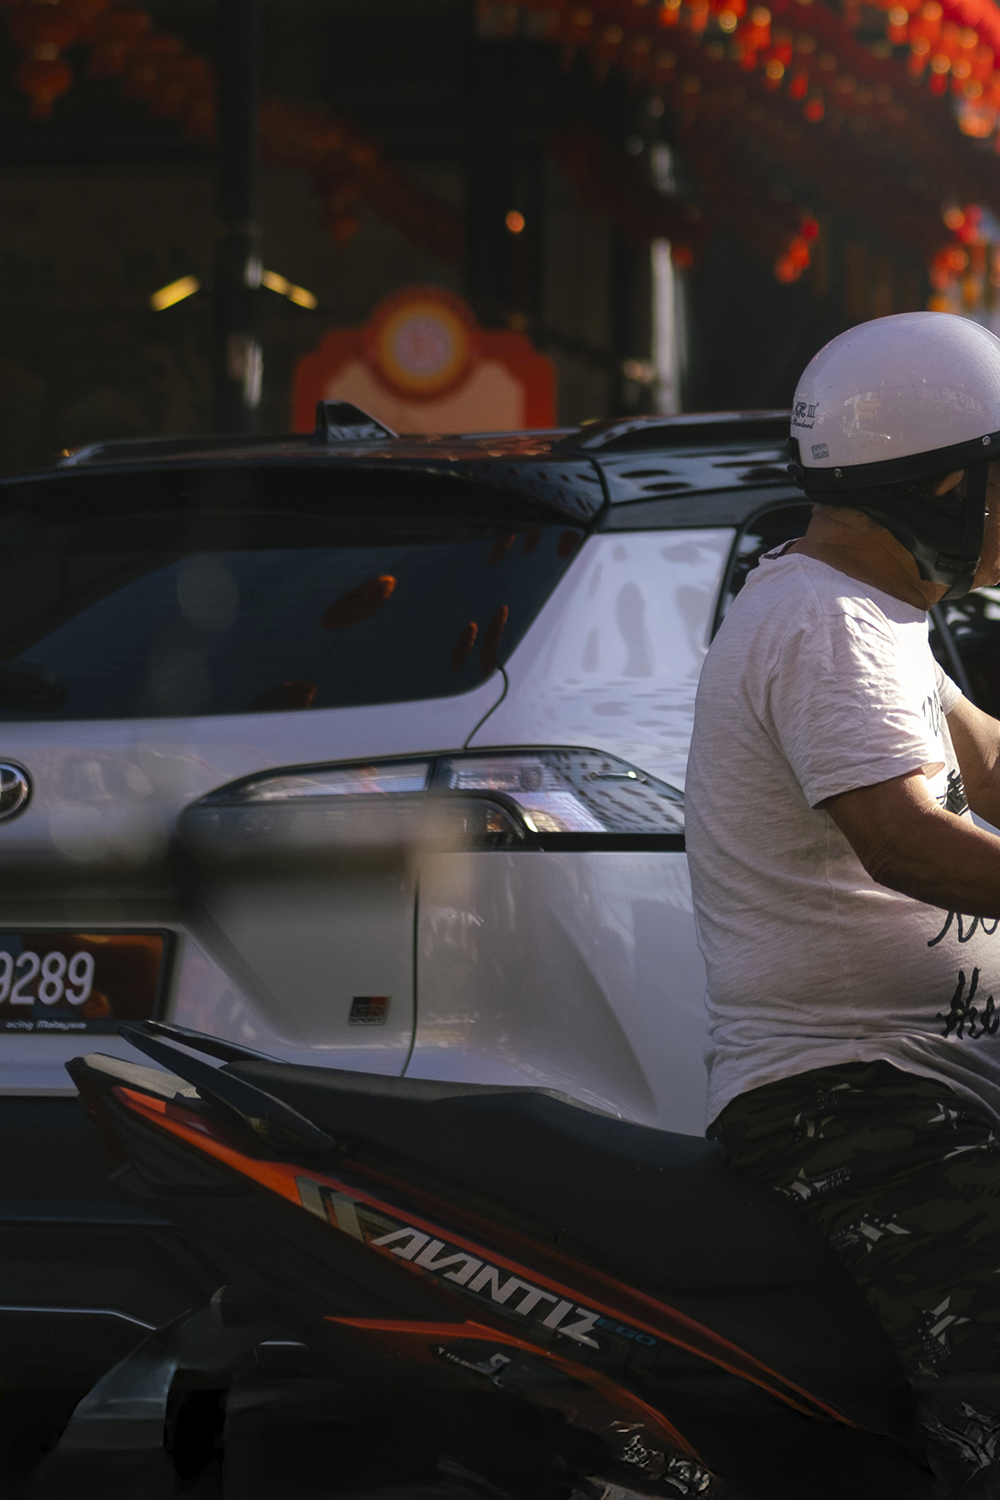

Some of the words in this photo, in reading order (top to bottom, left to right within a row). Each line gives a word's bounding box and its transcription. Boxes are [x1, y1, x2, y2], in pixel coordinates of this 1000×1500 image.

[5, 1019, 34, 1031] acing
[370, 1226, 601, 1349] AVANTIZ
[595, 1317, 657, 1347] EGO
